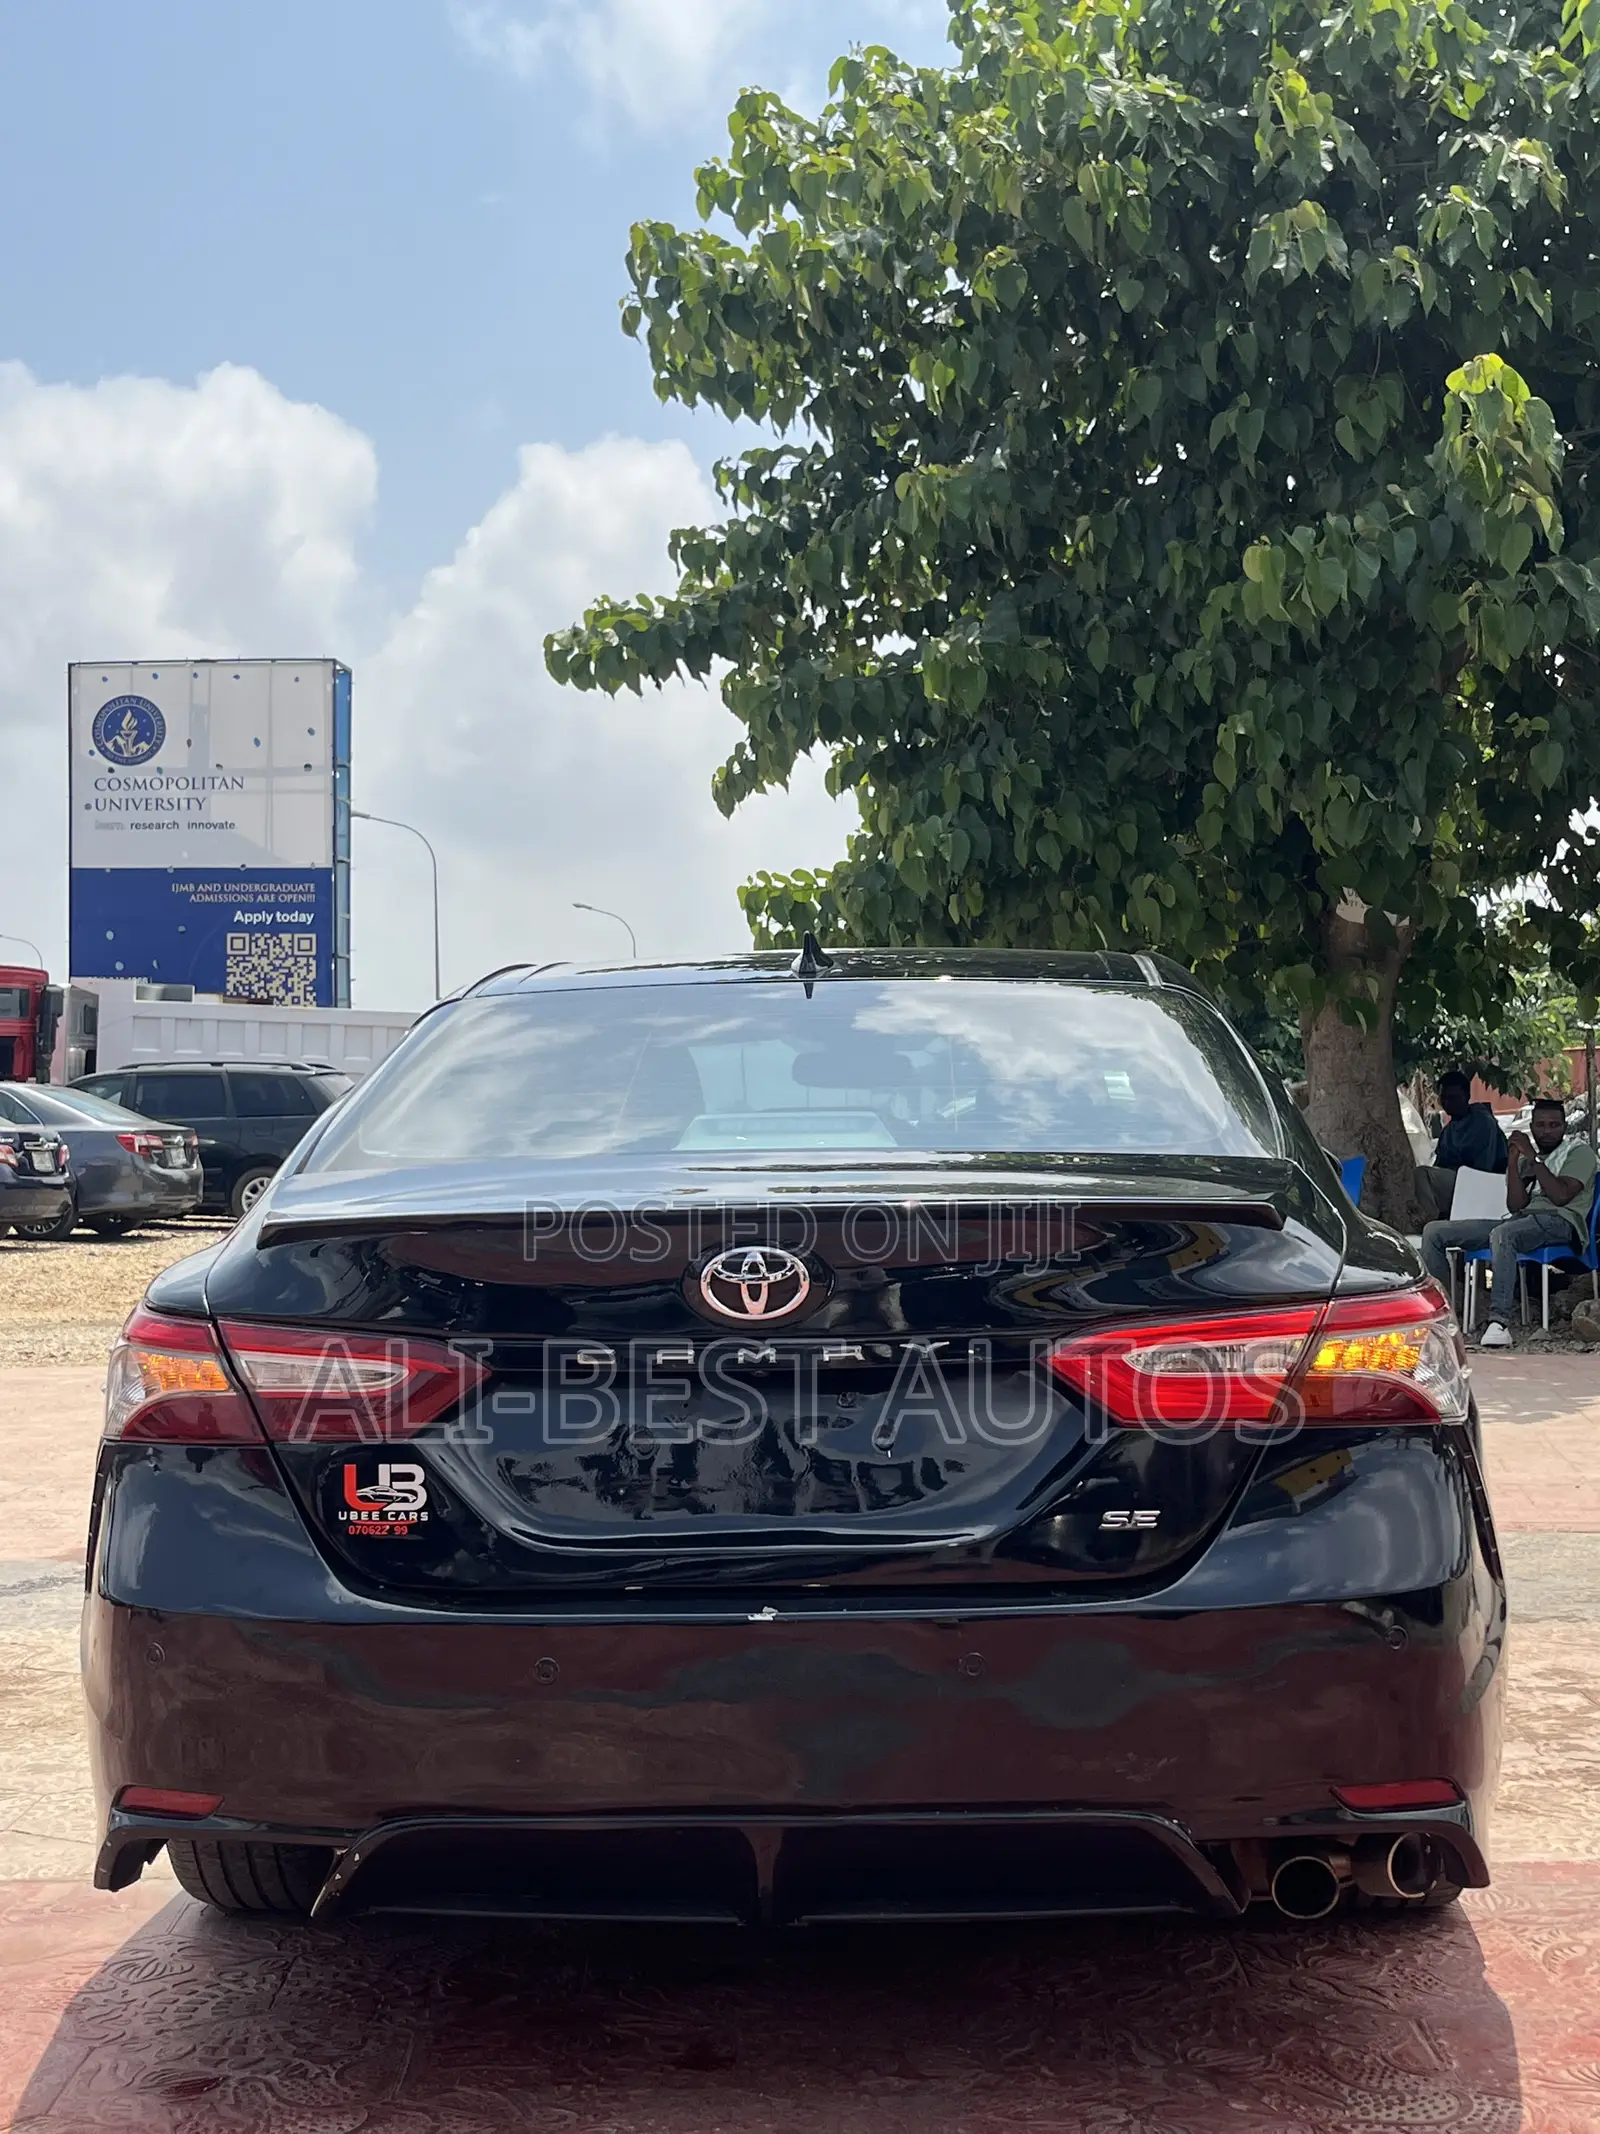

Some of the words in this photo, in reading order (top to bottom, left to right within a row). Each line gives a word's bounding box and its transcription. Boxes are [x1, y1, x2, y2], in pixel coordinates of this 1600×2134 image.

[94, 776, 245, 791] COSMOPOLITAN
[95, 797, 207, 811] UNIVERSITY
[130, 820, 180, 830] research
[187, 820, 236, 830] innovate
[172, 883, 195, 894] IJMB
[197, 883, 221, 892] AND
[224, 883, 316, 892] UNDERGRADUATE
[189, 894, 254, 903] ADMISSIONS
[256, 894, 276, 903] ARE
[278, 893, 316, 903] OPEN!!!
[233, 910, 274, 925] Apply
[276, 910, 315, 925] today
[576, 1341, 950, 1367] CAMRY
[338, 1511, 380, 1521] UBEE
[387, 1511, 429, 1521] CARS
[1099, 1510, 1161, 1530] SE
